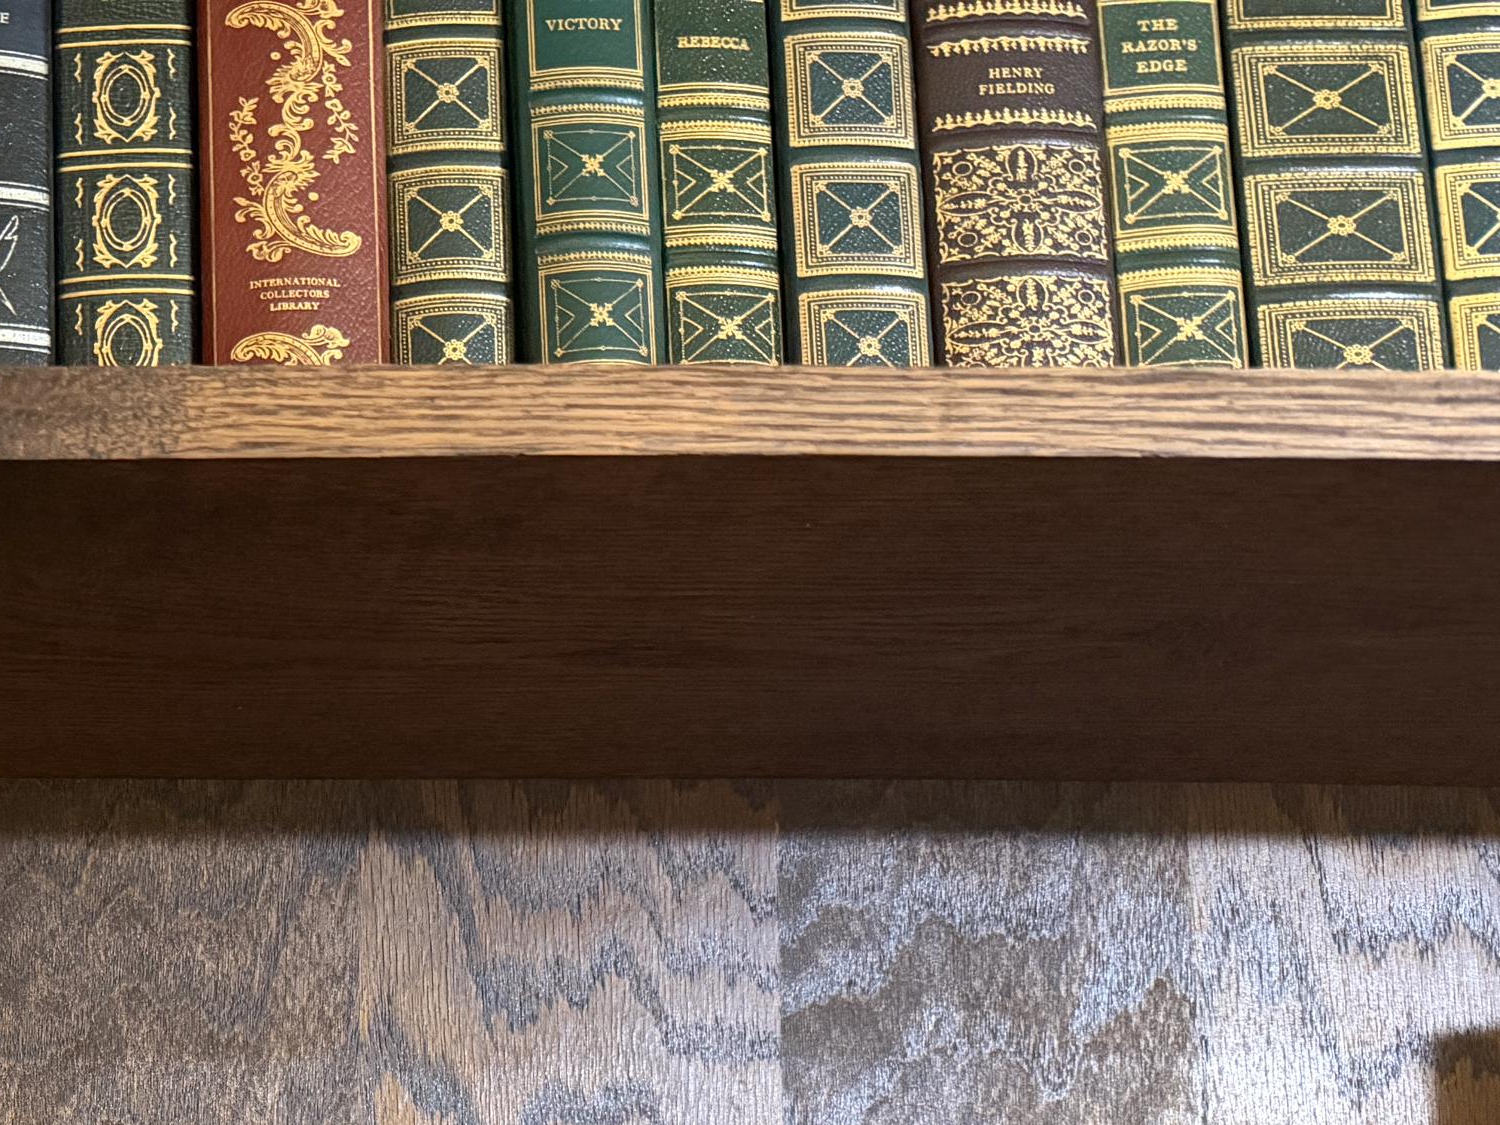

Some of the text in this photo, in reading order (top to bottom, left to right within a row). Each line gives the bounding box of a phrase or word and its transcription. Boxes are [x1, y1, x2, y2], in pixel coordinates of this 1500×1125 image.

[545, 18, 622, 31] VICTORY
[1137, 18, 1179, 32] THE
[677, 36, 750, 50] REBECCA
[1121, 39, 1198, 54] RAZOR'S
[1136, 59, 1187, 74] EDGE
[988, 67, 1044, 80] HENRY
[978, 82, 1056, 96] FIELDING
[249, 277, 341, 290] INTERNATIONAL
[259, 289, 330, 300] COLLECTORS
[269, 301, 320, 312] LIBRARY
